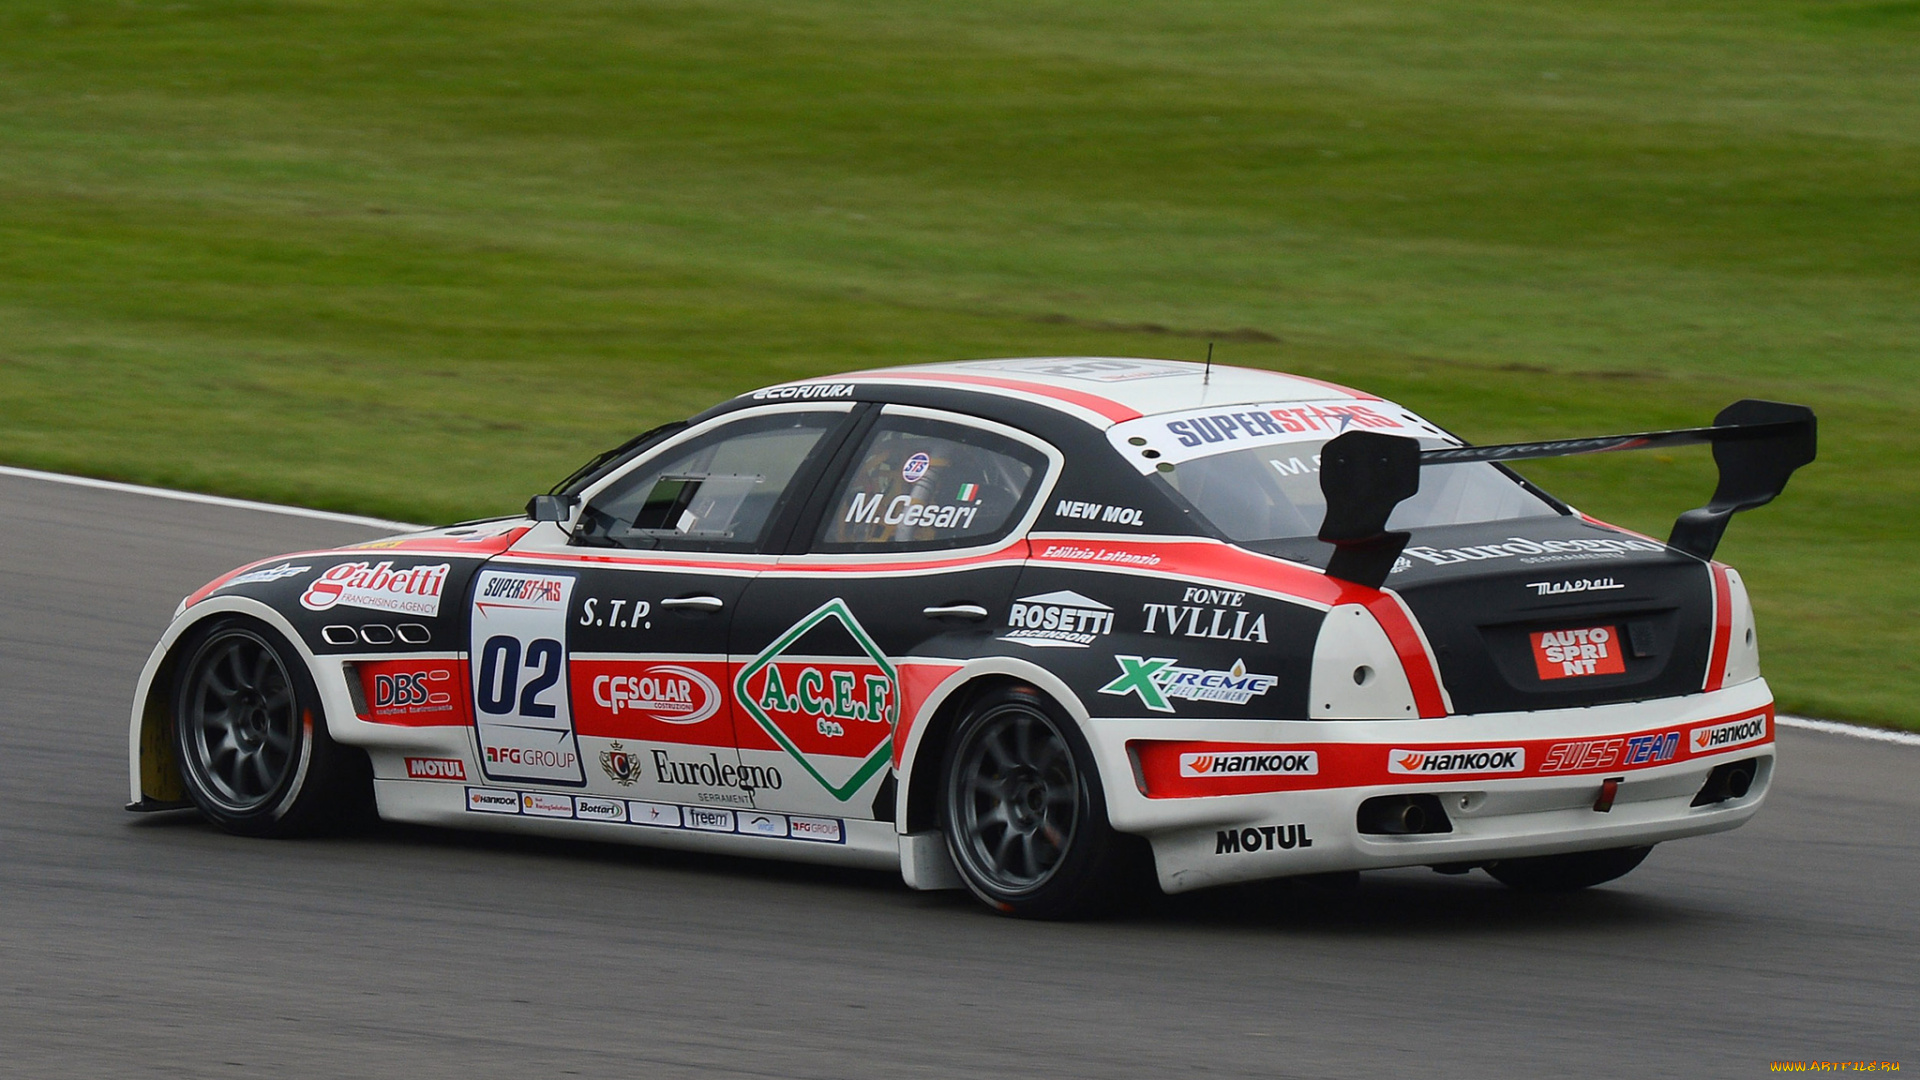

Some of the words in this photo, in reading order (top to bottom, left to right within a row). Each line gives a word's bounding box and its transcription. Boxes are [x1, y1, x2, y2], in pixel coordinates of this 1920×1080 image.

[1166, 404, 1404, 448] SUPERSTARS
[1055, 500, 1102, 521] NEW
[1101, 506, 1144, 526] MOL
[1041, 545, 1095, 560] Edilizia
[1093, 549, 1161, 566] Lattanzio
[1403, 537, 1666, 566] Eurolegno
[304, 563, 445, 606] gabetti
[484, 577, 562, 603] SUPERSTARS
[1526, 577, 1624, 596] Maserati
[342, 593, 398, 609] FRANCHISING
[400, 601, 437, 613] AGENCY
[1182, 587, 1245, 607] FONTE
[580, 597, 651, 629] S.T.P.
[1008, 604, 1115, 635] ROSETTI
[1143, 604, 1269, 643] TVLLIA
[1005, 629, 1097, 644] ASCENSORI
[1541, 628, 1609, 648] AUTO
[1545, 645, 1608, 663] SPRI
[477, 635, 562, 718] 02
[1564, 659, 1597, 676] NT
[375, 671, 428, 708] DBS
[1102, 657, 1271, 710] XTREME
[654, 702, 693, 710] COSTRUZIONI
[500, 747, 521, 764] FG
[523, 750, 576, 768] GROUP
[1539, 738, 1624, 773] SWISS
[1622, 732, 1681, 765] TEAM
[411, 760, 464, 778] MOTUL
[651, 749, 782, 796] Eurolegno
[579, 802, 615, 814] Bottari
[690, 809, 728, 827] freem
[799, 822, 811, 832] FG
[811, 824, 838, 834] GROUP
[1215, 824, 1312, 854] MOTUL
